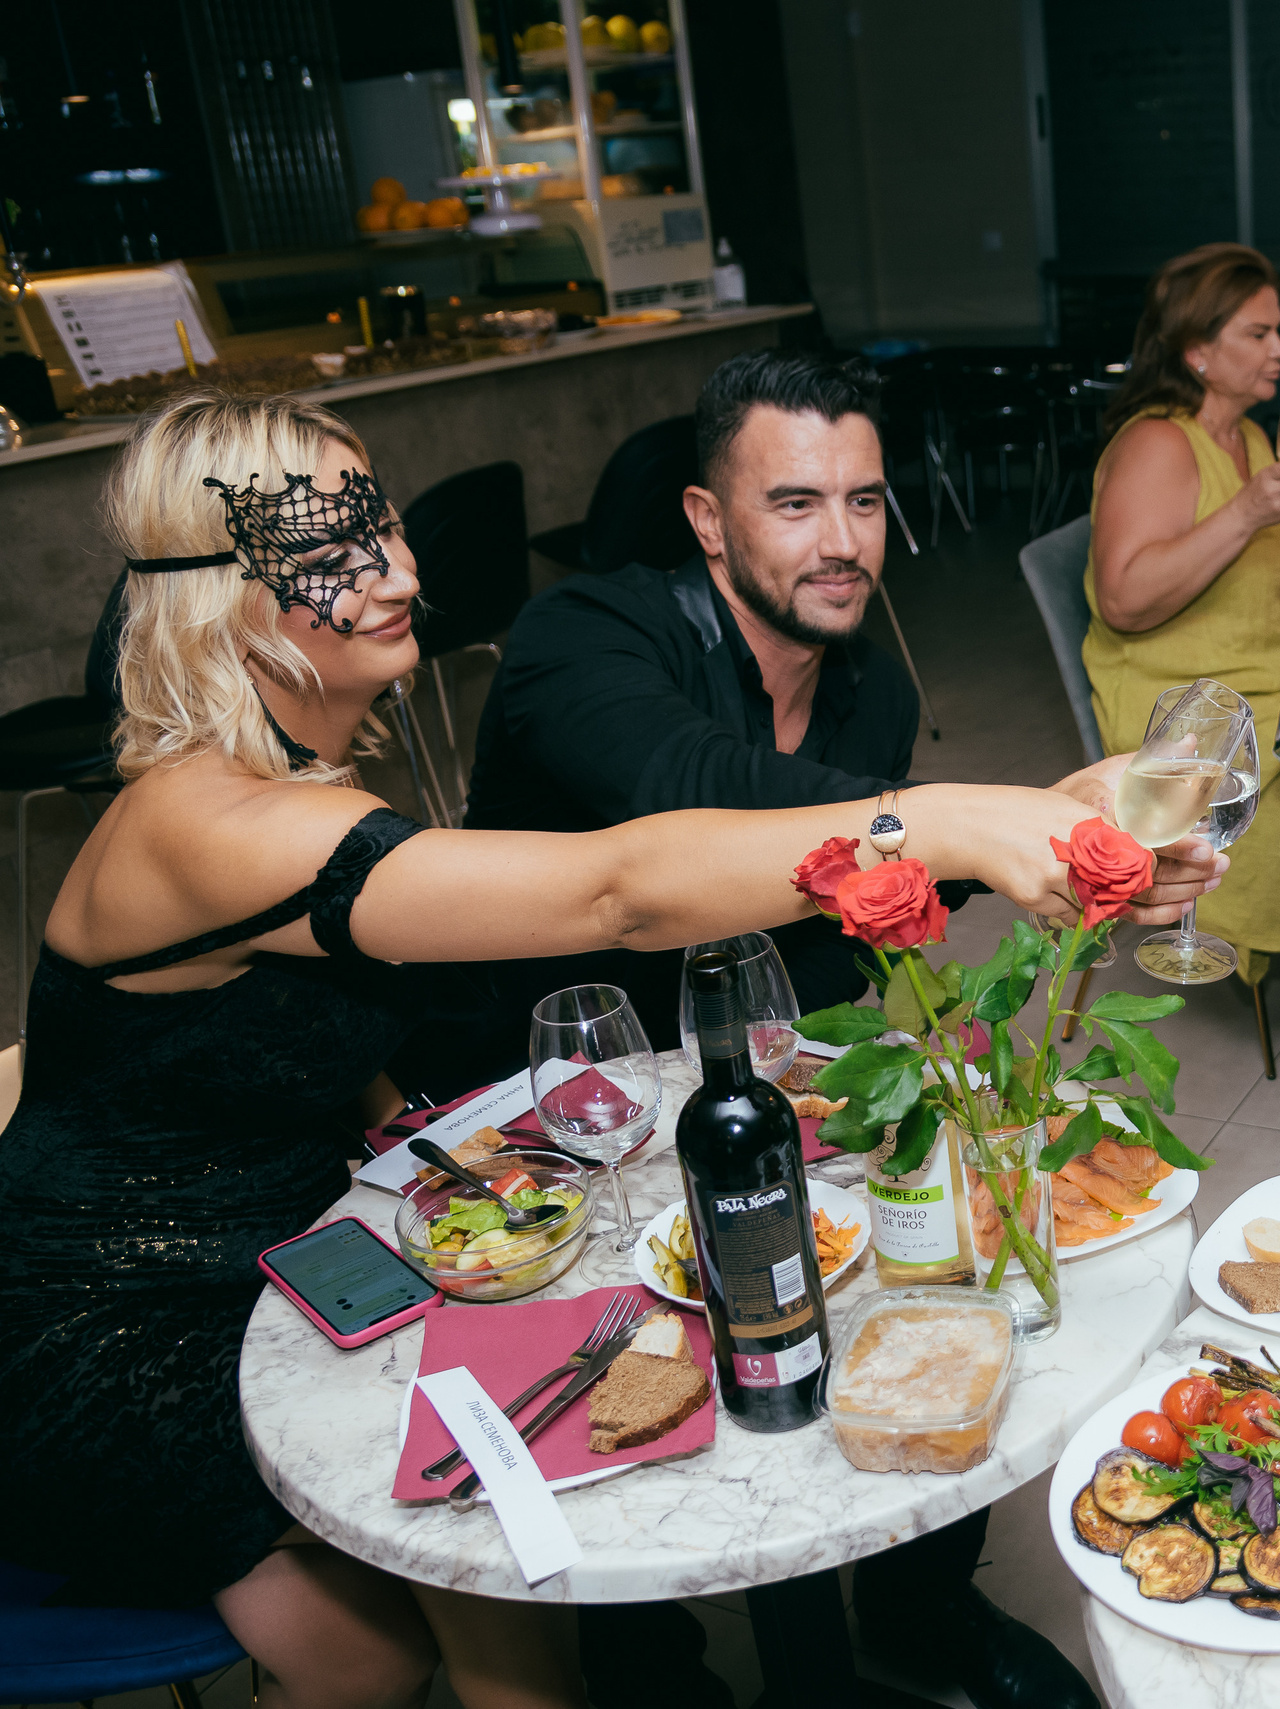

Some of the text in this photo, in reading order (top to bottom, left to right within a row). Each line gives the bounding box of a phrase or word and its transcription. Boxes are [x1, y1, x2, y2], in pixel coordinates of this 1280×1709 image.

[444, 1084, 524, 1131] АННА СЕМЕНОВА
[716, 1197, 748, 1213] PATA
[747, 1188, 788, 1209] NEGRA
[872, 1184, 930, 1201] VERDEJO
[878, 1204, 927, 1220] SEÑORÍO
[881, 1216, 925, 1230] DE IROS
[740, 1375, 776, 1384] Valdepeñas
[466, 1400, 518, 1471] ЛИЗА СЕМЕНОВА
